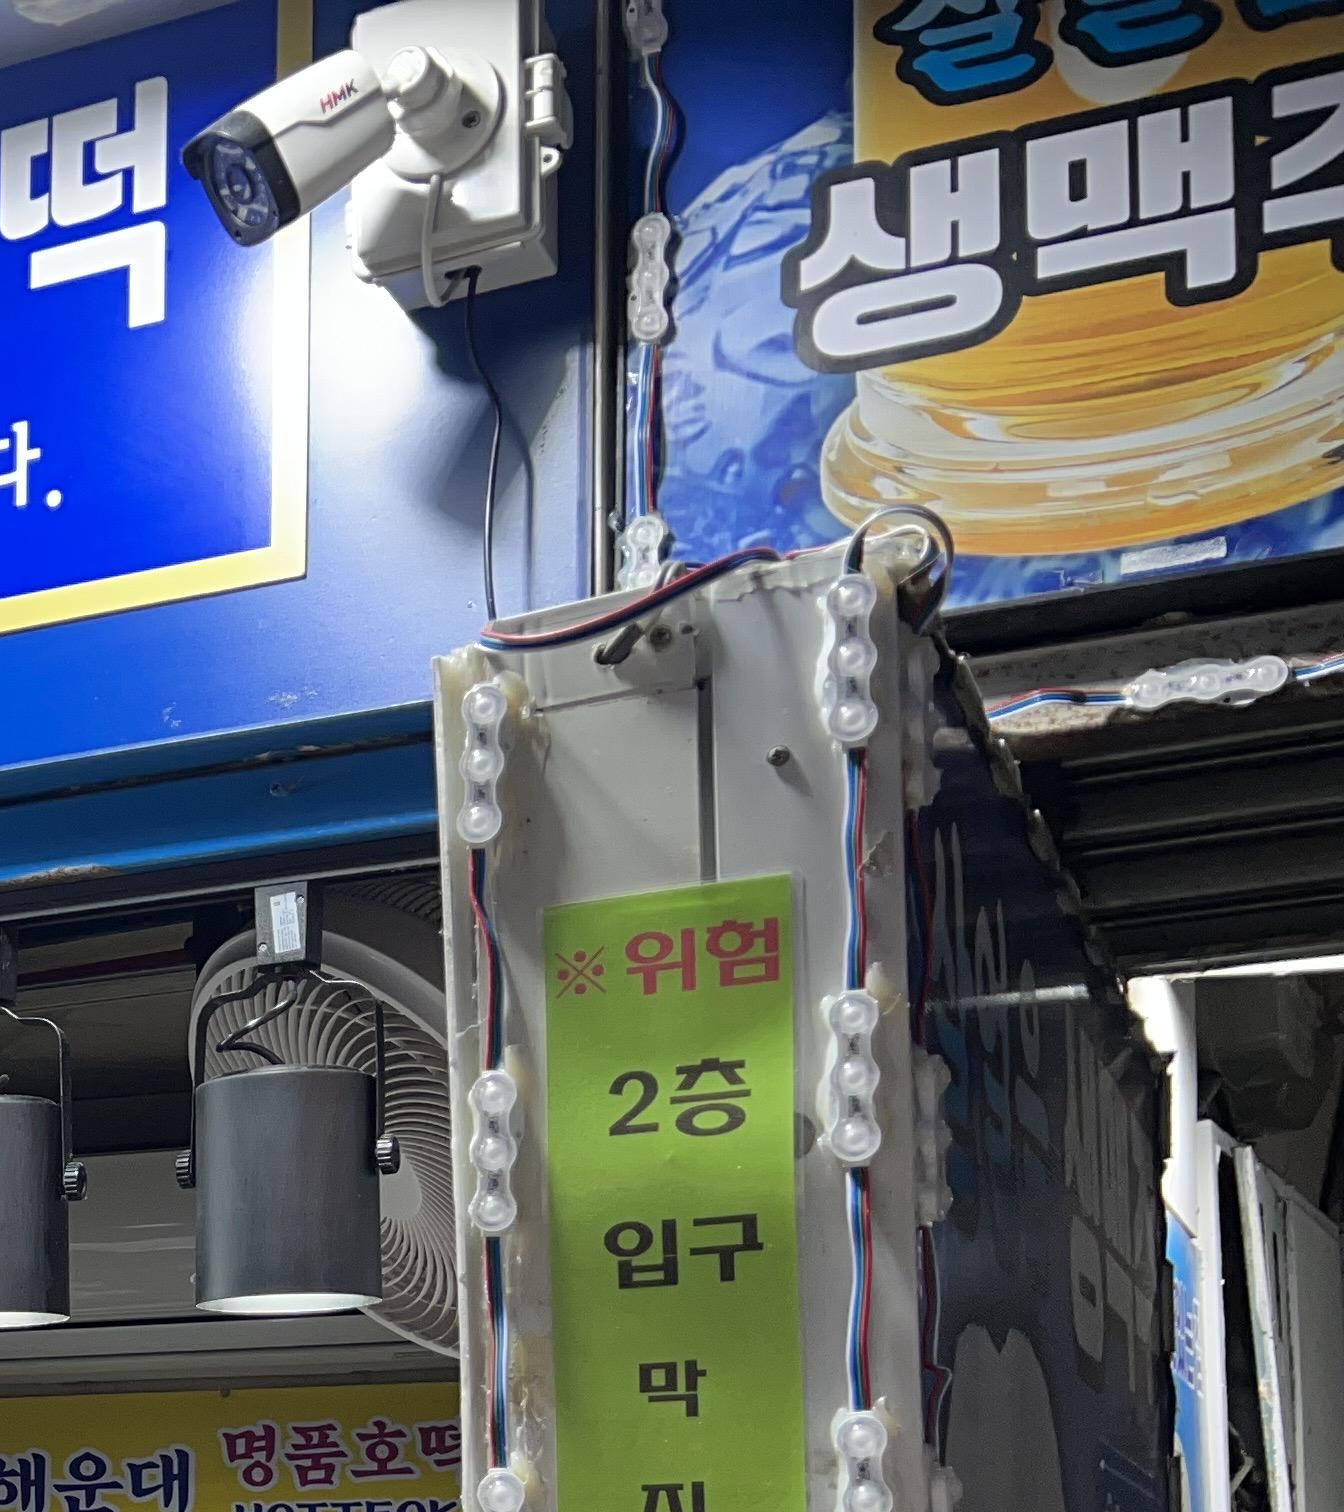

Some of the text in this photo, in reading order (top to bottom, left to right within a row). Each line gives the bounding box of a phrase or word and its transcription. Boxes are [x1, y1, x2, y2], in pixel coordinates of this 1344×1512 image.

[319, 79, 359, 114] HMK
[608, 1056, 753, 1140] 2층
[603, 1211, 765, 1291] 입구
